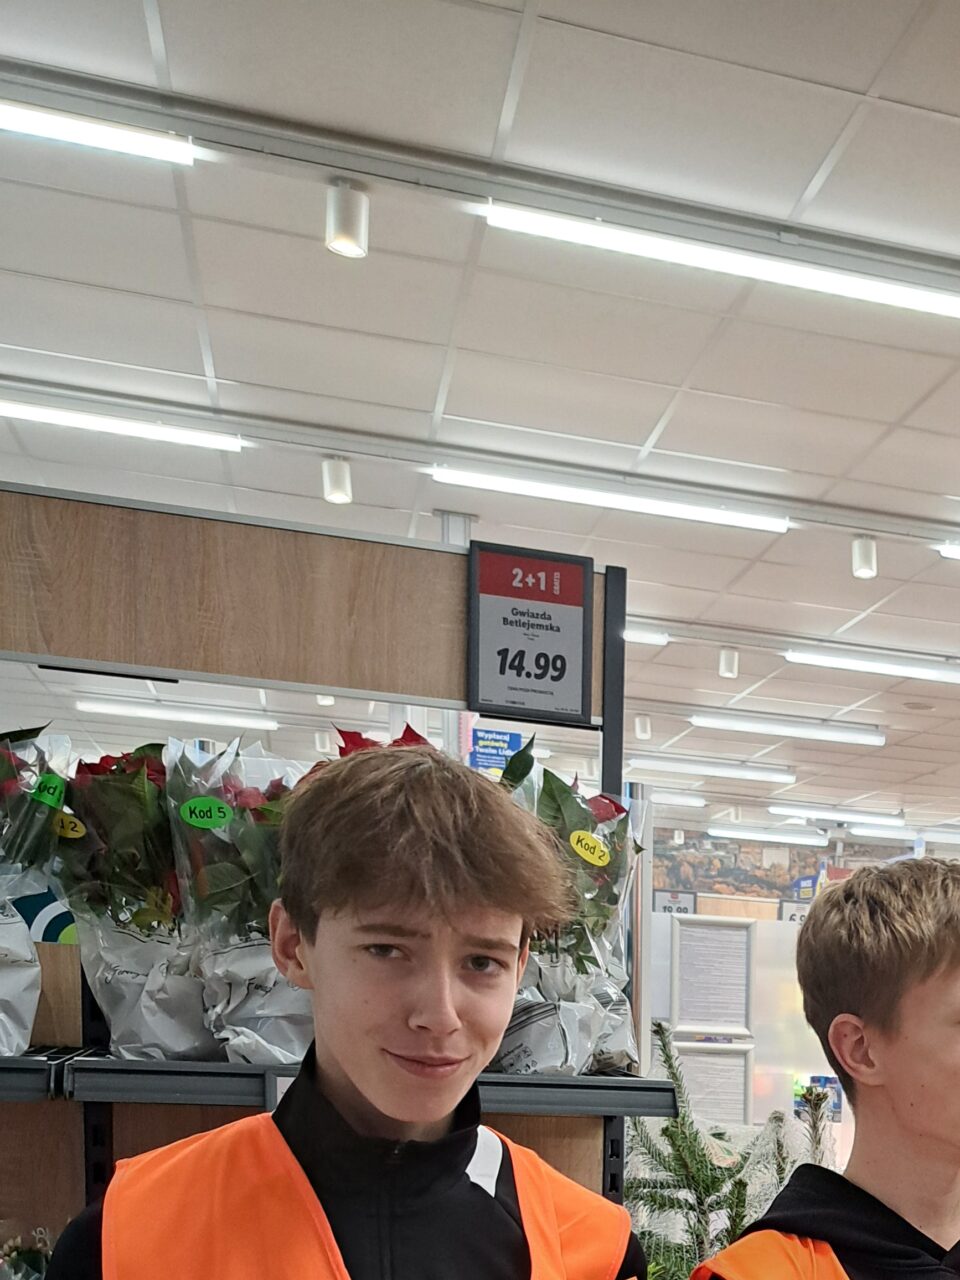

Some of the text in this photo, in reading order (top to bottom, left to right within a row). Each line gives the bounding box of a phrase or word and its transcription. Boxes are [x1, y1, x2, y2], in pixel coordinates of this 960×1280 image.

[511, 567, 547, 591] 2+1
[511, 607, 552, 621] Gwiazda
[502, 617, 561, 633] Betlejemska
[496, 647, 567, 682] 14.99
[188, 805, 227, 820] Kod 5
[575, 834, 606, 863] Kod 2
